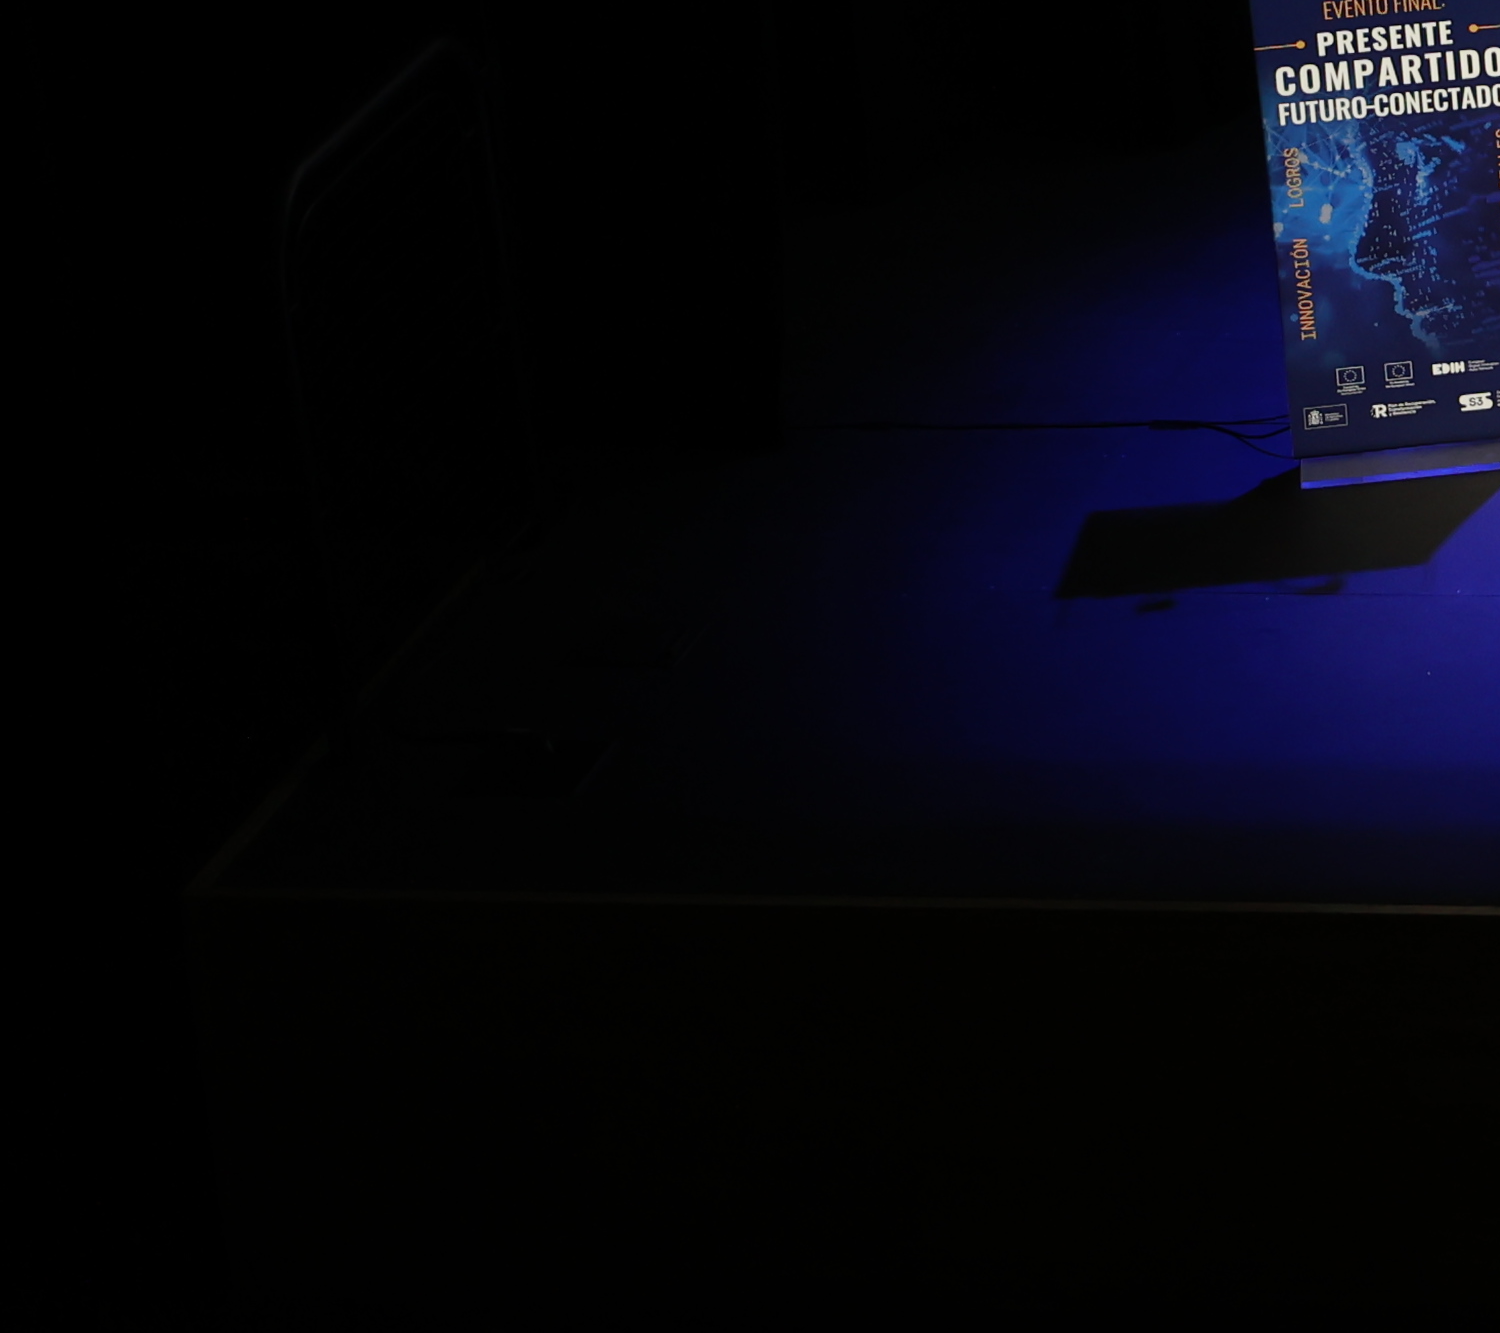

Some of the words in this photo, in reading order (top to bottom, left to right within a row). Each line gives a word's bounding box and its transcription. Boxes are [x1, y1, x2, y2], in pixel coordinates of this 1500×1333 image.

[1316, 20, 1453, 57] PRESENTE
[1283, 147, 1304, 208] LOGROS
[1290, 238, 1317, 341] INNOVACIÓN
[1431, 361, 1465, 376] EDIH
